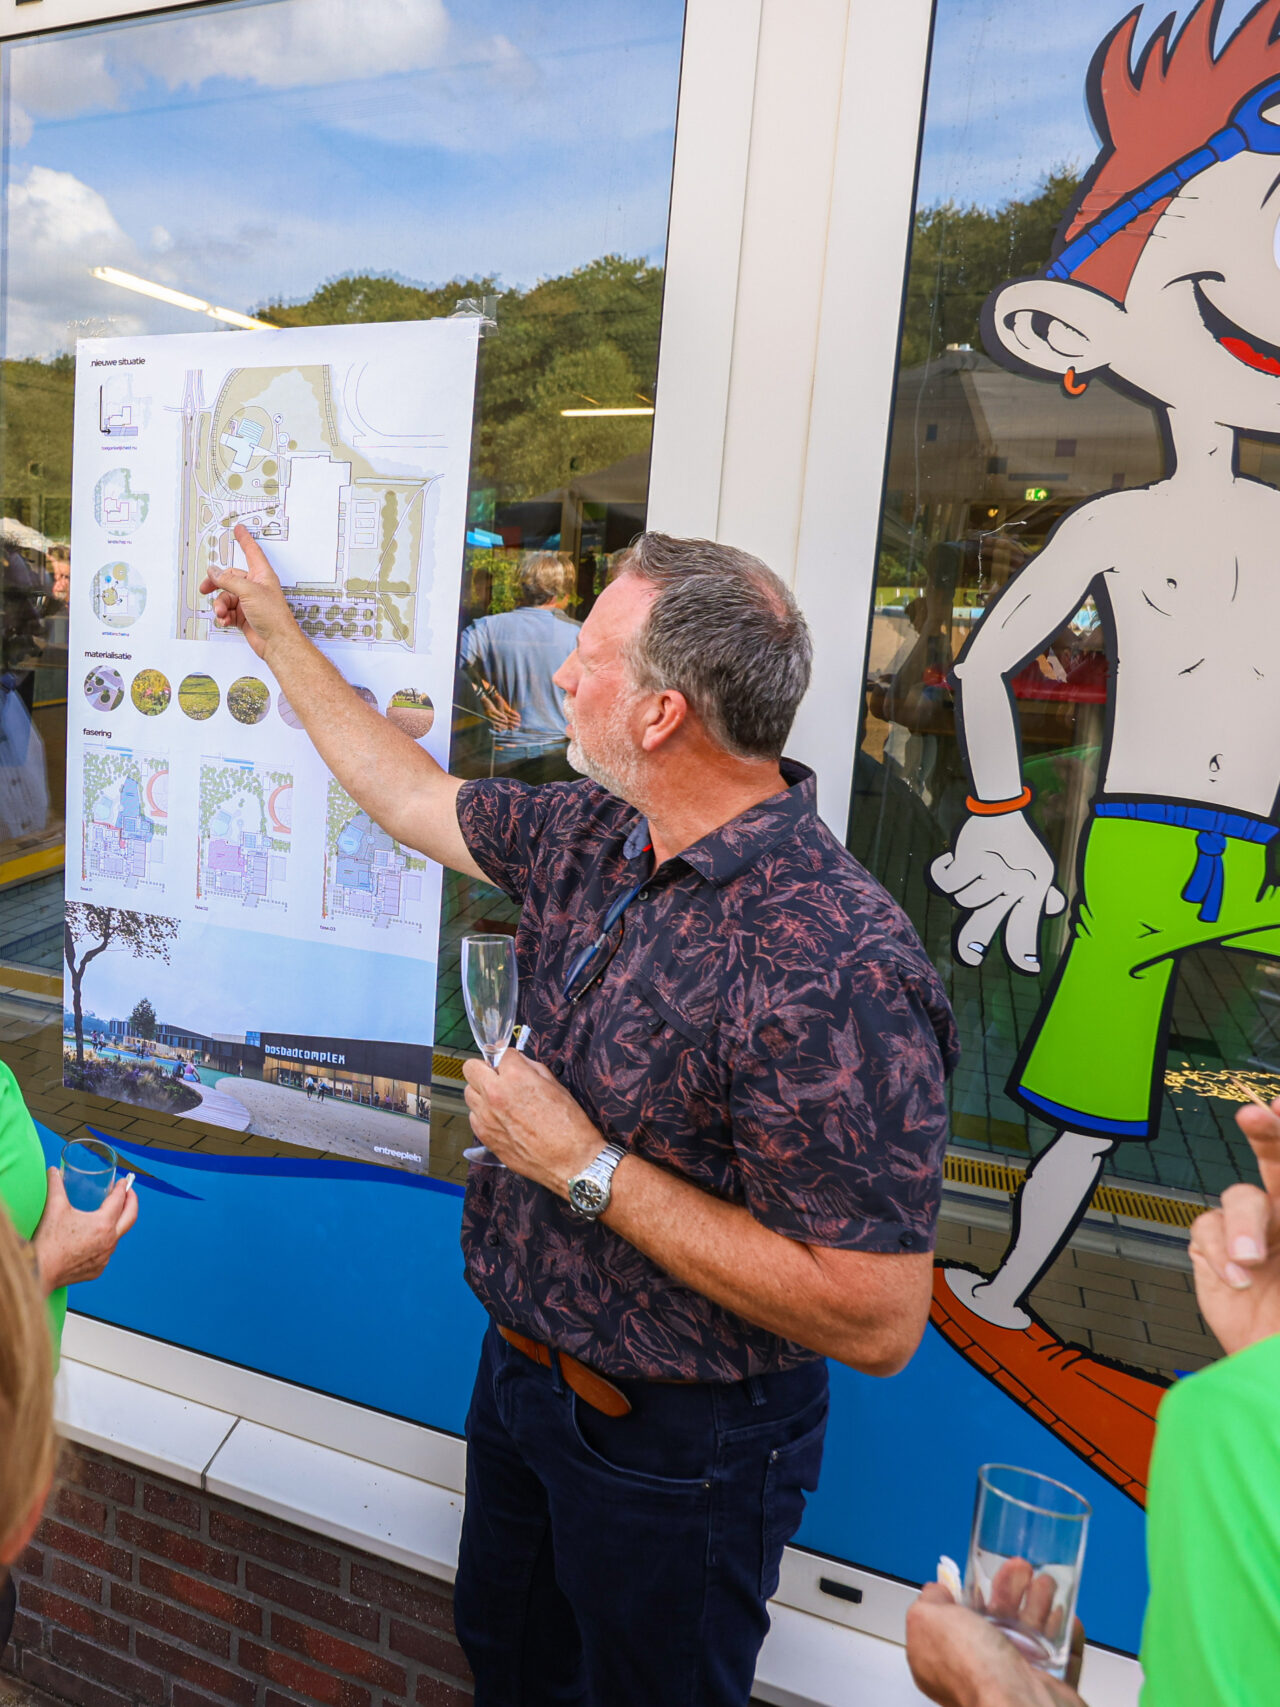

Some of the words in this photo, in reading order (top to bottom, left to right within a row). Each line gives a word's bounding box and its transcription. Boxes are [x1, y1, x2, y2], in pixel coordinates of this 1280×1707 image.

[90, 359, 118, 367] nieuwe
[118, 356, 146, 366] situatie
[84, 650, 133, 661] materialisatie
[83, 728, 112, 739] fasering
[373, 1145, 422, 1163] entreeplein
